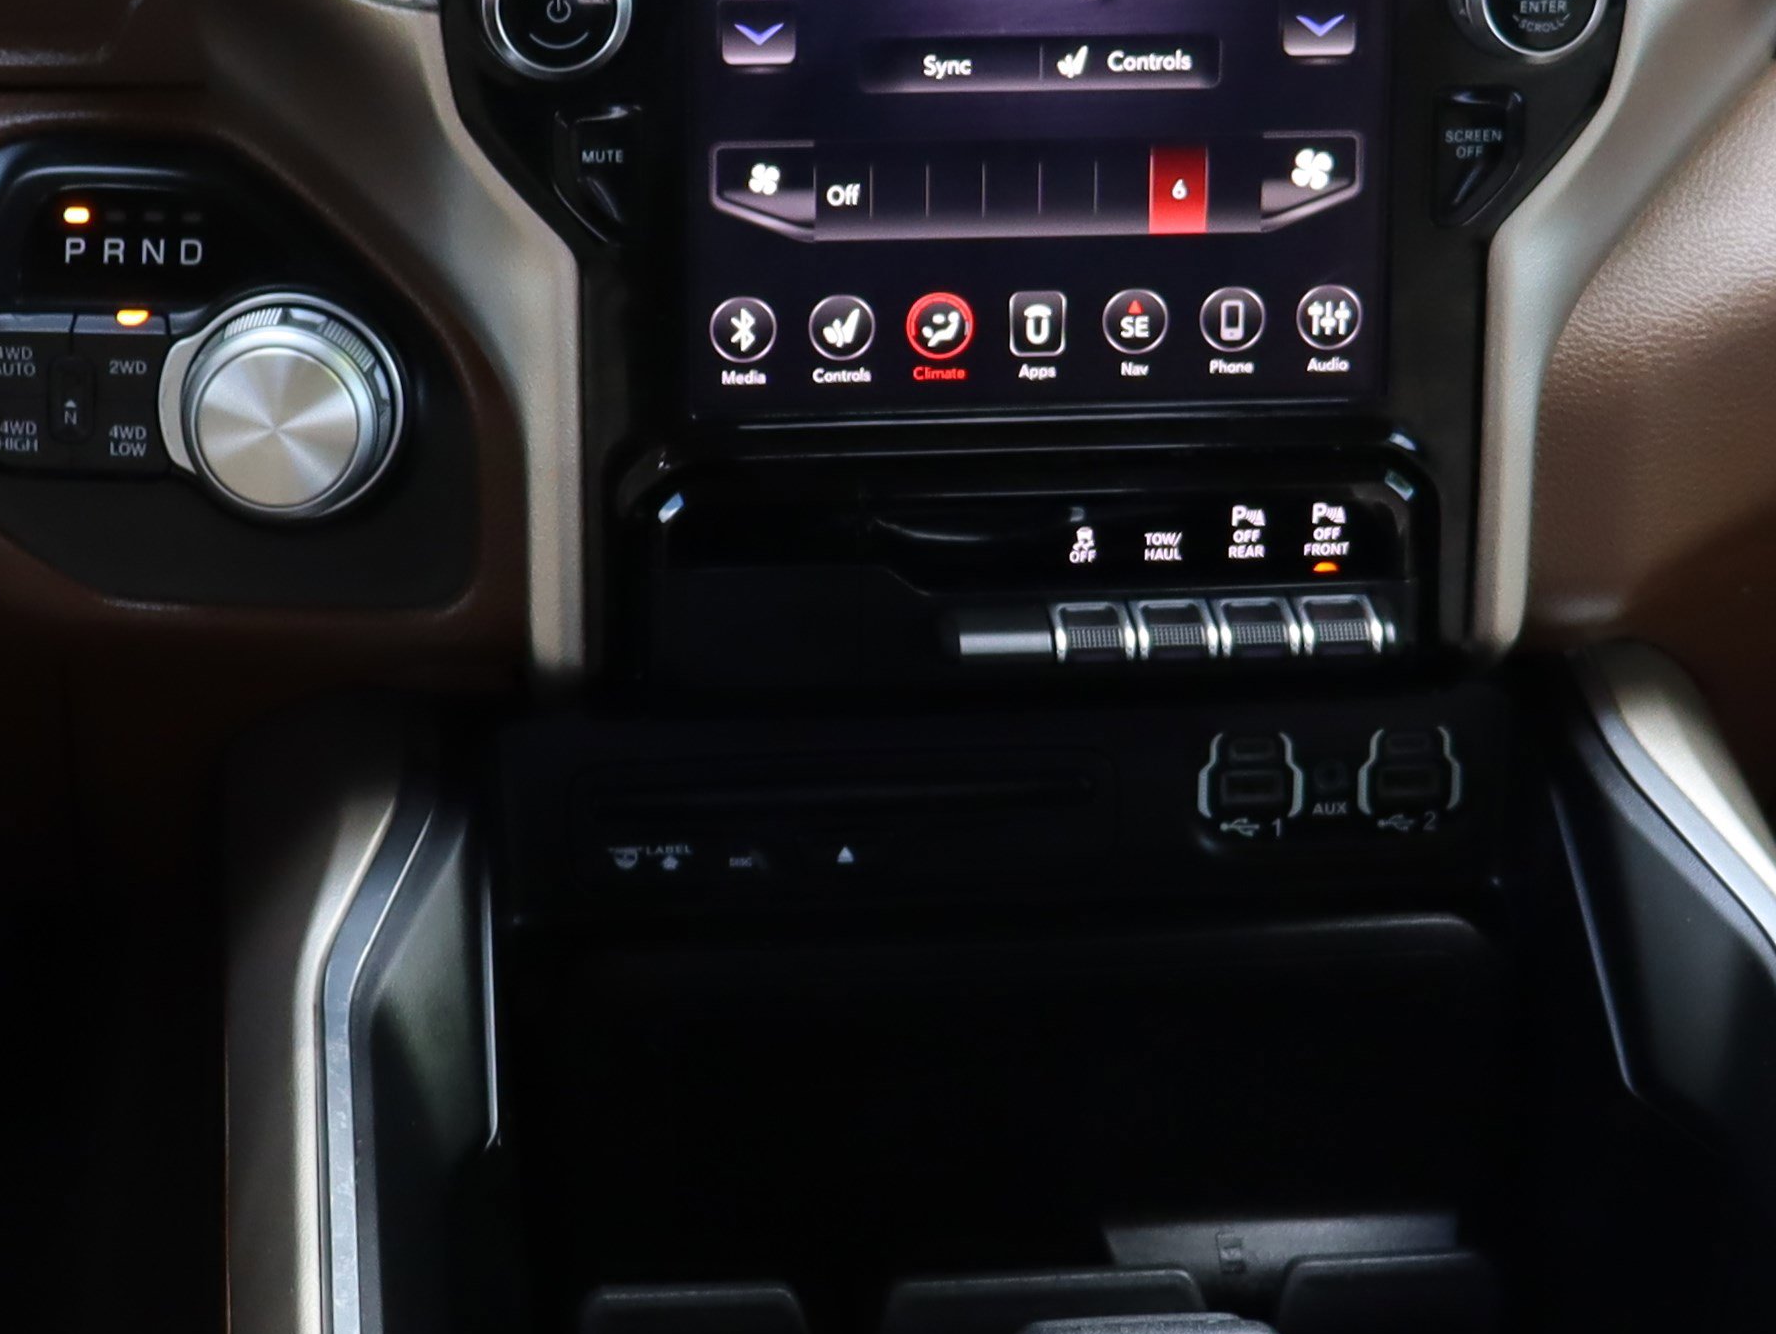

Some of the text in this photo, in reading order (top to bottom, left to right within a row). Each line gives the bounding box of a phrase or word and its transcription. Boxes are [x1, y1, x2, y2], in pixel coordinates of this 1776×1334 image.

[1519, 0, 1568, 14] ENTER
[1518, 18, 1565, 34] SCROLL
[923, 53, 972, 80] Sync
[1106, 48, 1193, 75] Controls
[1445, 129, 1503, 143] SCREEN
[582, 149, 624, 163] MUTE
[1456, 145, 1484, 159] OFF
[826, 183, 861, 209] Off
[1171, 179, 1188, 201] 6
[64, 237, 203, 265] P R N D
[1119, 315, 1150, 340] SE
[109, 359, 148, 376] 2WD
[912, 364, 966, 382] Climate
[1018, 364, 1057, 382] Apps
[1120, 361, 1149, 378] Nav
[1208, 359, 1254, 376] Phone
[1306, 357, 1350, 373] Audio
[721, 369, 768, 387] Media
[812, 367, 872, 385] Controls
[0, 420, 38, 436] 4WD
[108, 424, 147, 441] 4WD
[109, 440, 147, 458] LOW
[1232, 529, 1262, 544] OFF
[1313, 526, 1342, 541] OFF
[1069, 547, 1097, 564] OFF
[1144, 546, 1182, 563] HAUL
[1228, 544, 1266, 559] REAR
[1303, 540, 1350, 557] FRONT
[1311, 799, 1348, 817] AUX
[1272, 818, 1284, 838] 1
[1422, 811, 1437, 831] 2
